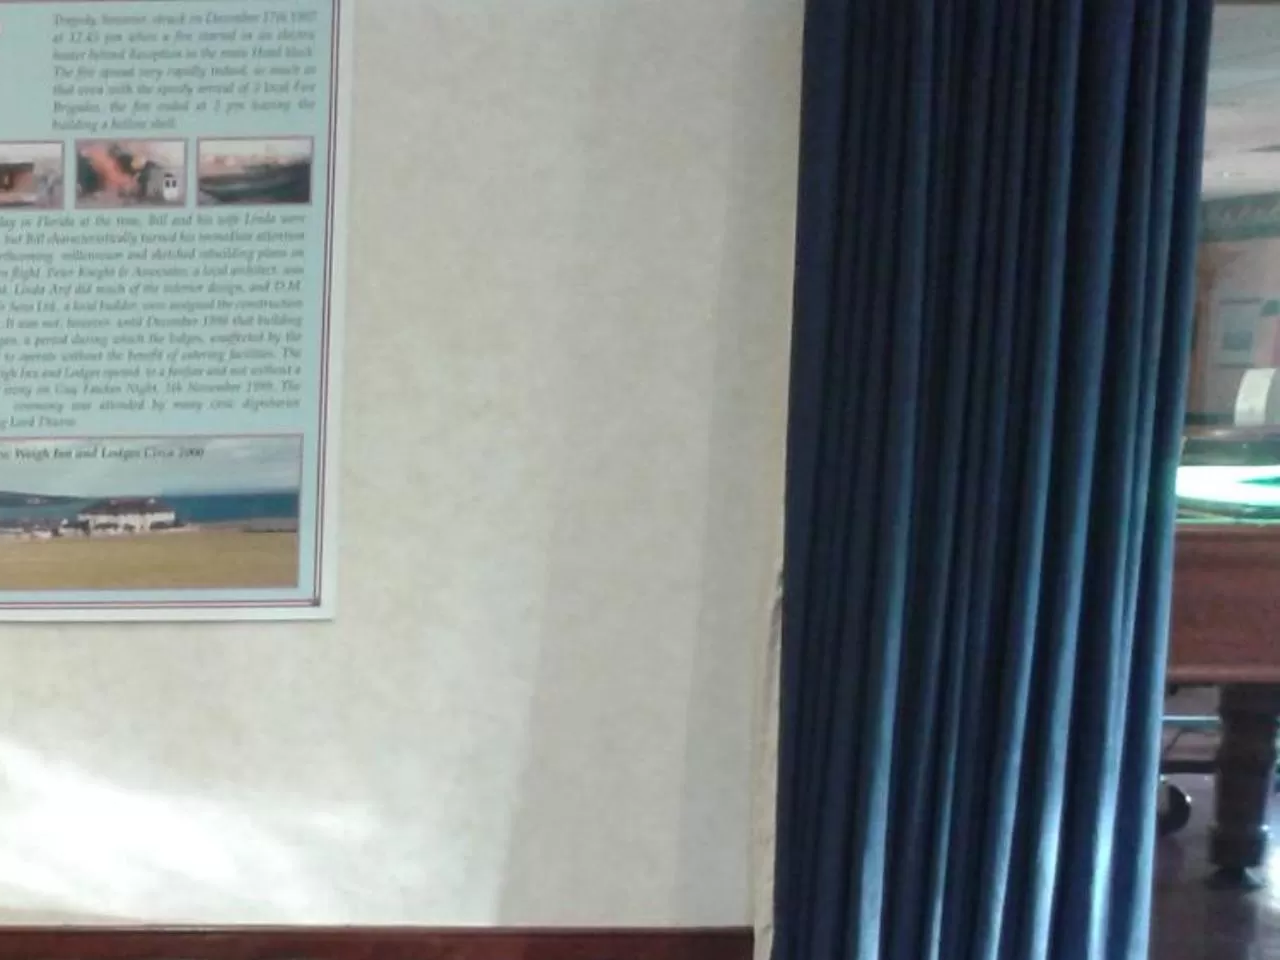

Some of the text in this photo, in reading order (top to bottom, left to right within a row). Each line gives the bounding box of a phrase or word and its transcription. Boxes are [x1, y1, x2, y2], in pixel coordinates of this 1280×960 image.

[15, 447, 49, 461] Weigh
[54, 447, 72, 459] Inn
[75, 447, 97, 459] and
[102, 447, 140, 460] Lodges
[144, 447, 174, 459] Circa
